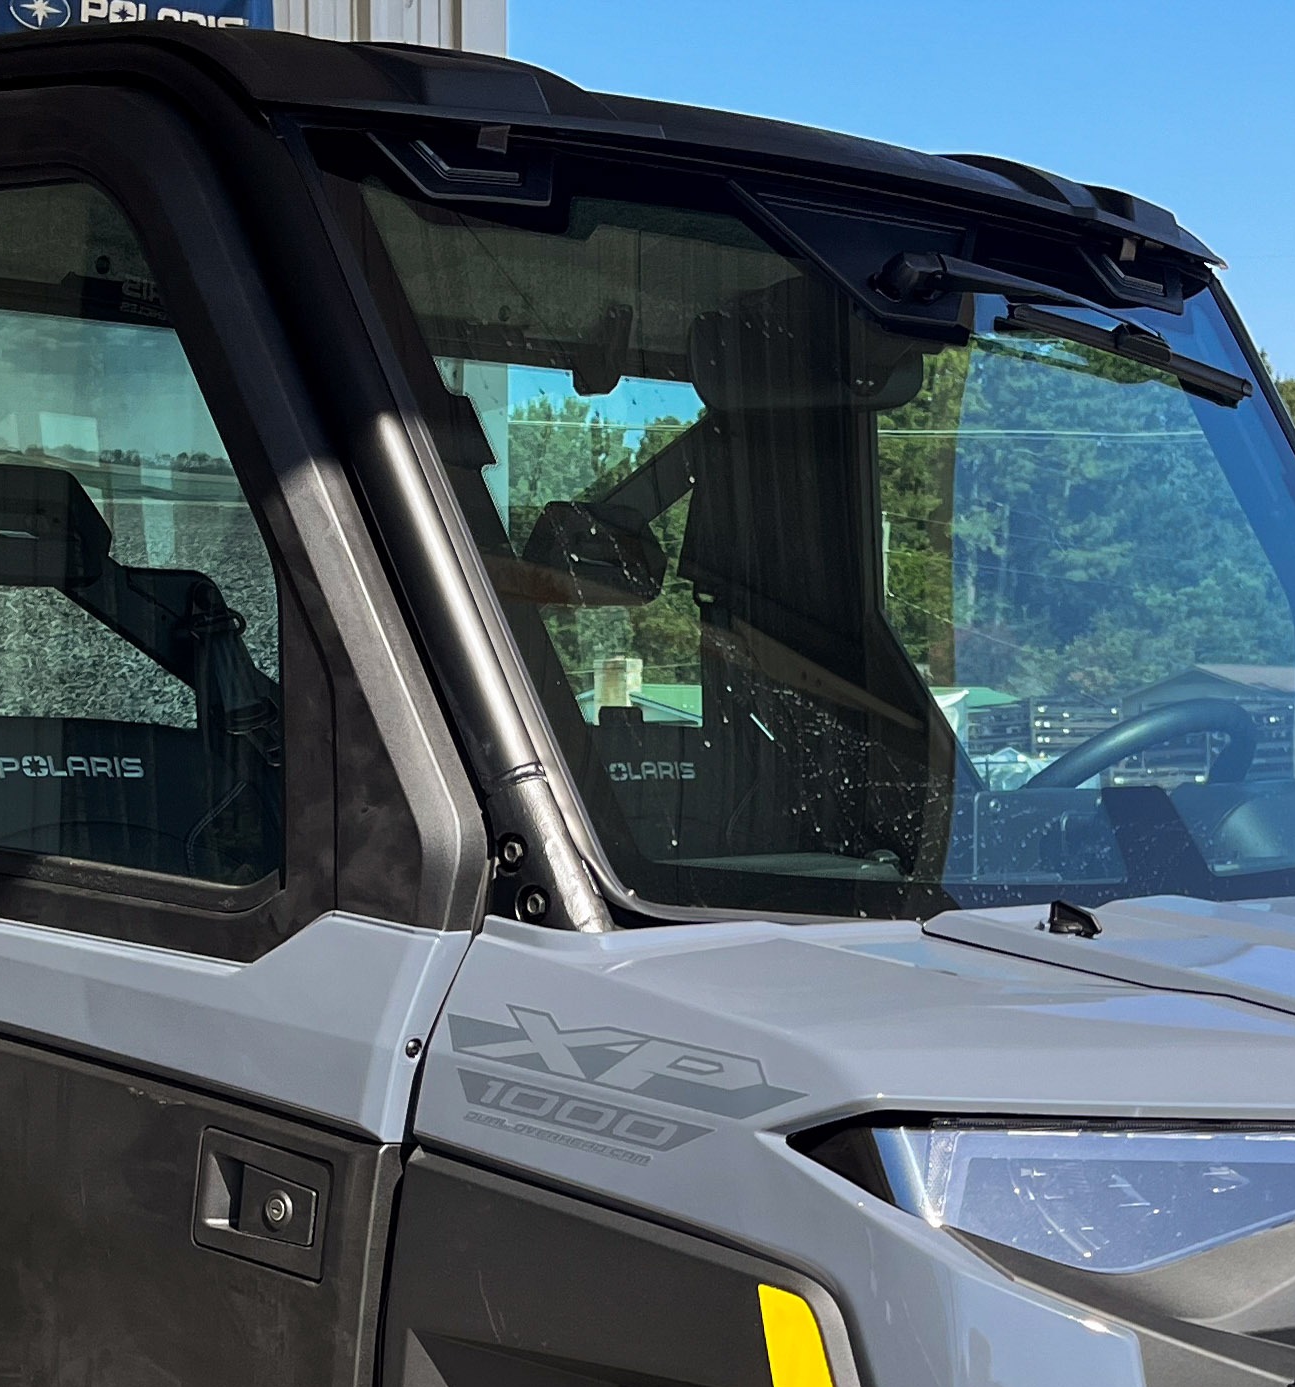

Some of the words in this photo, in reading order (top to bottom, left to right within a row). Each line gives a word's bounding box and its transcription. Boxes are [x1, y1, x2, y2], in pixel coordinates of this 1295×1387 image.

[607, 761, 696, 782] OLARIS
[451, 1003, 788, 1100] XP
[462, 1110, 506, 1131] DUAL
[608, 1147, 654, 1168] CAM
[476, 1079, 680, 1148] 1000
